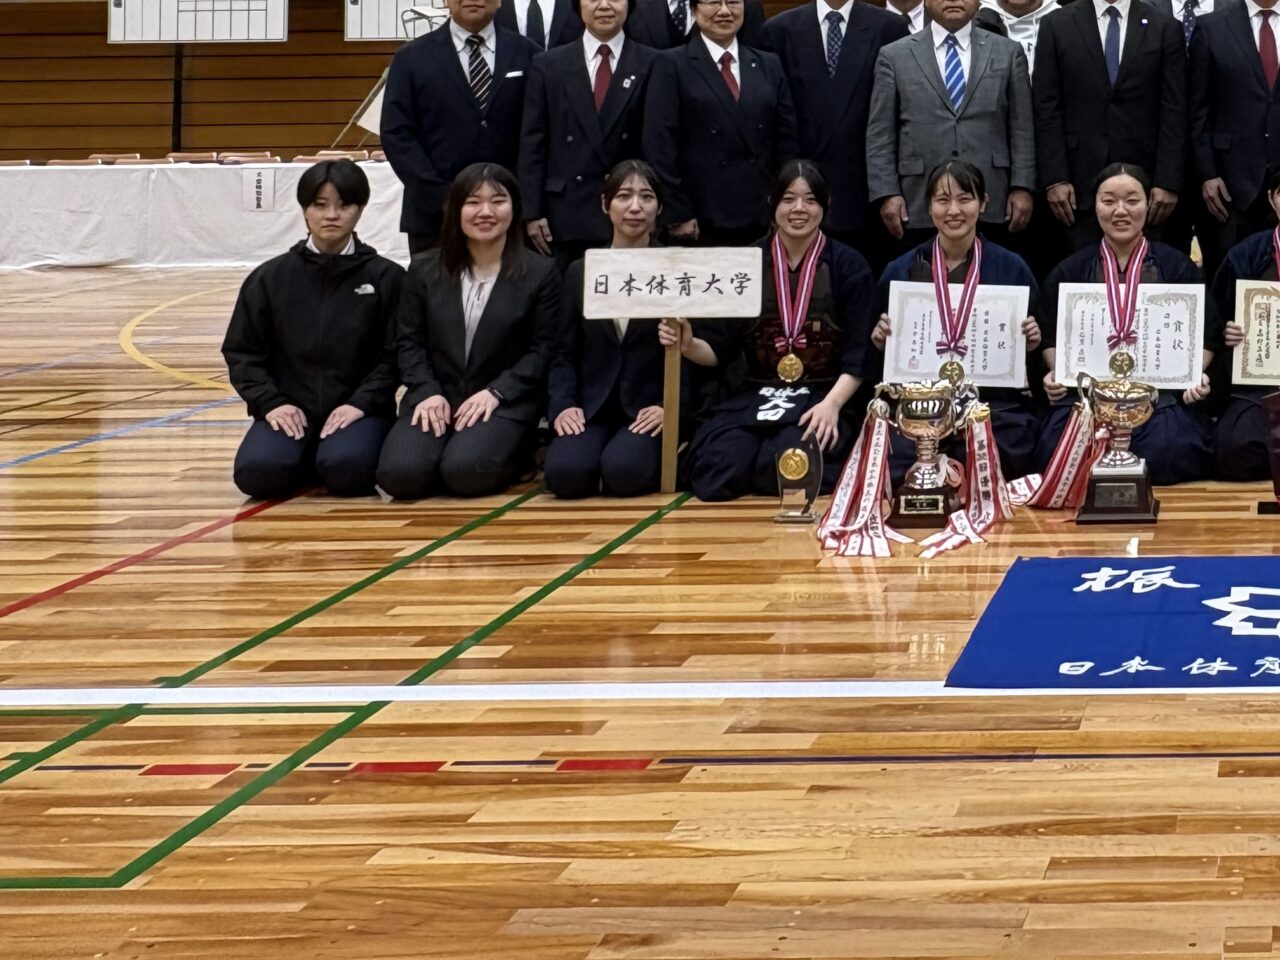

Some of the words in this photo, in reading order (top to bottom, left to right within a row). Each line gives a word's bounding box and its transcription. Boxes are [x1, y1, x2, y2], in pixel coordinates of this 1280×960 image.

[594, 272, 752, 297] 日本体育大学
